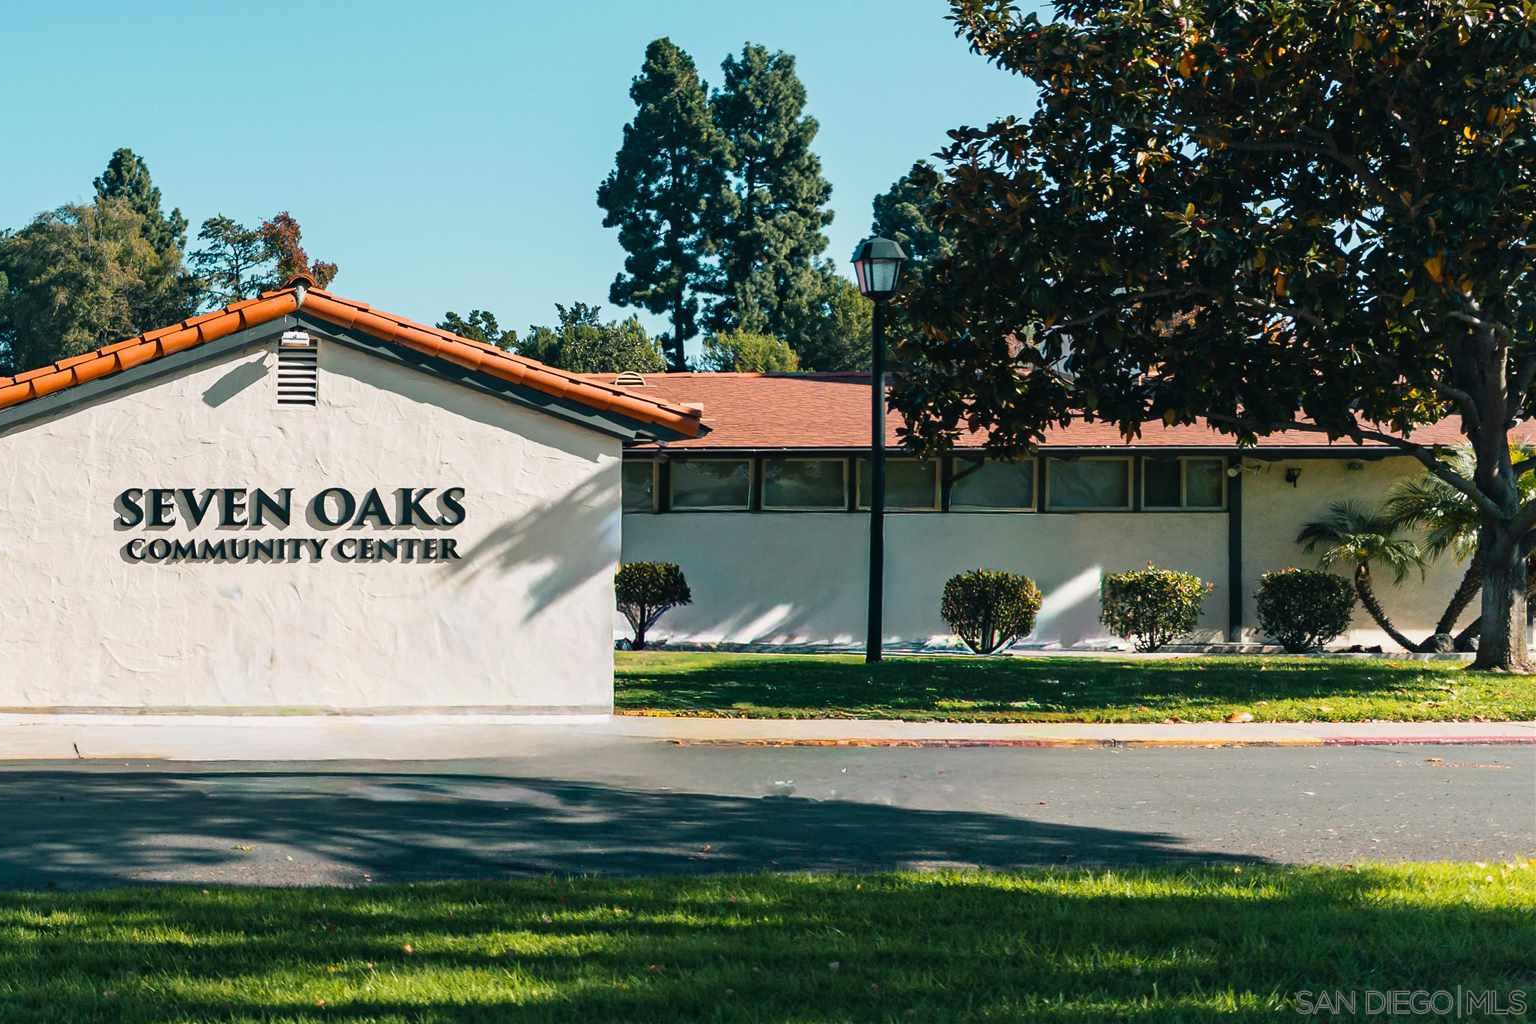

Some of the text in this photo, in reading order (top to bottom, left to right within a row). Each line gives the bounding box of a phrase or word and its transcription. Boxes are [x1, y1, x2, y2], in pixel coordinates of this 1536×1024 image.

[116, 487, 465, 529] SEVEN OAKS
[123, 538, 462, 562] COMMUNITY CENTER
